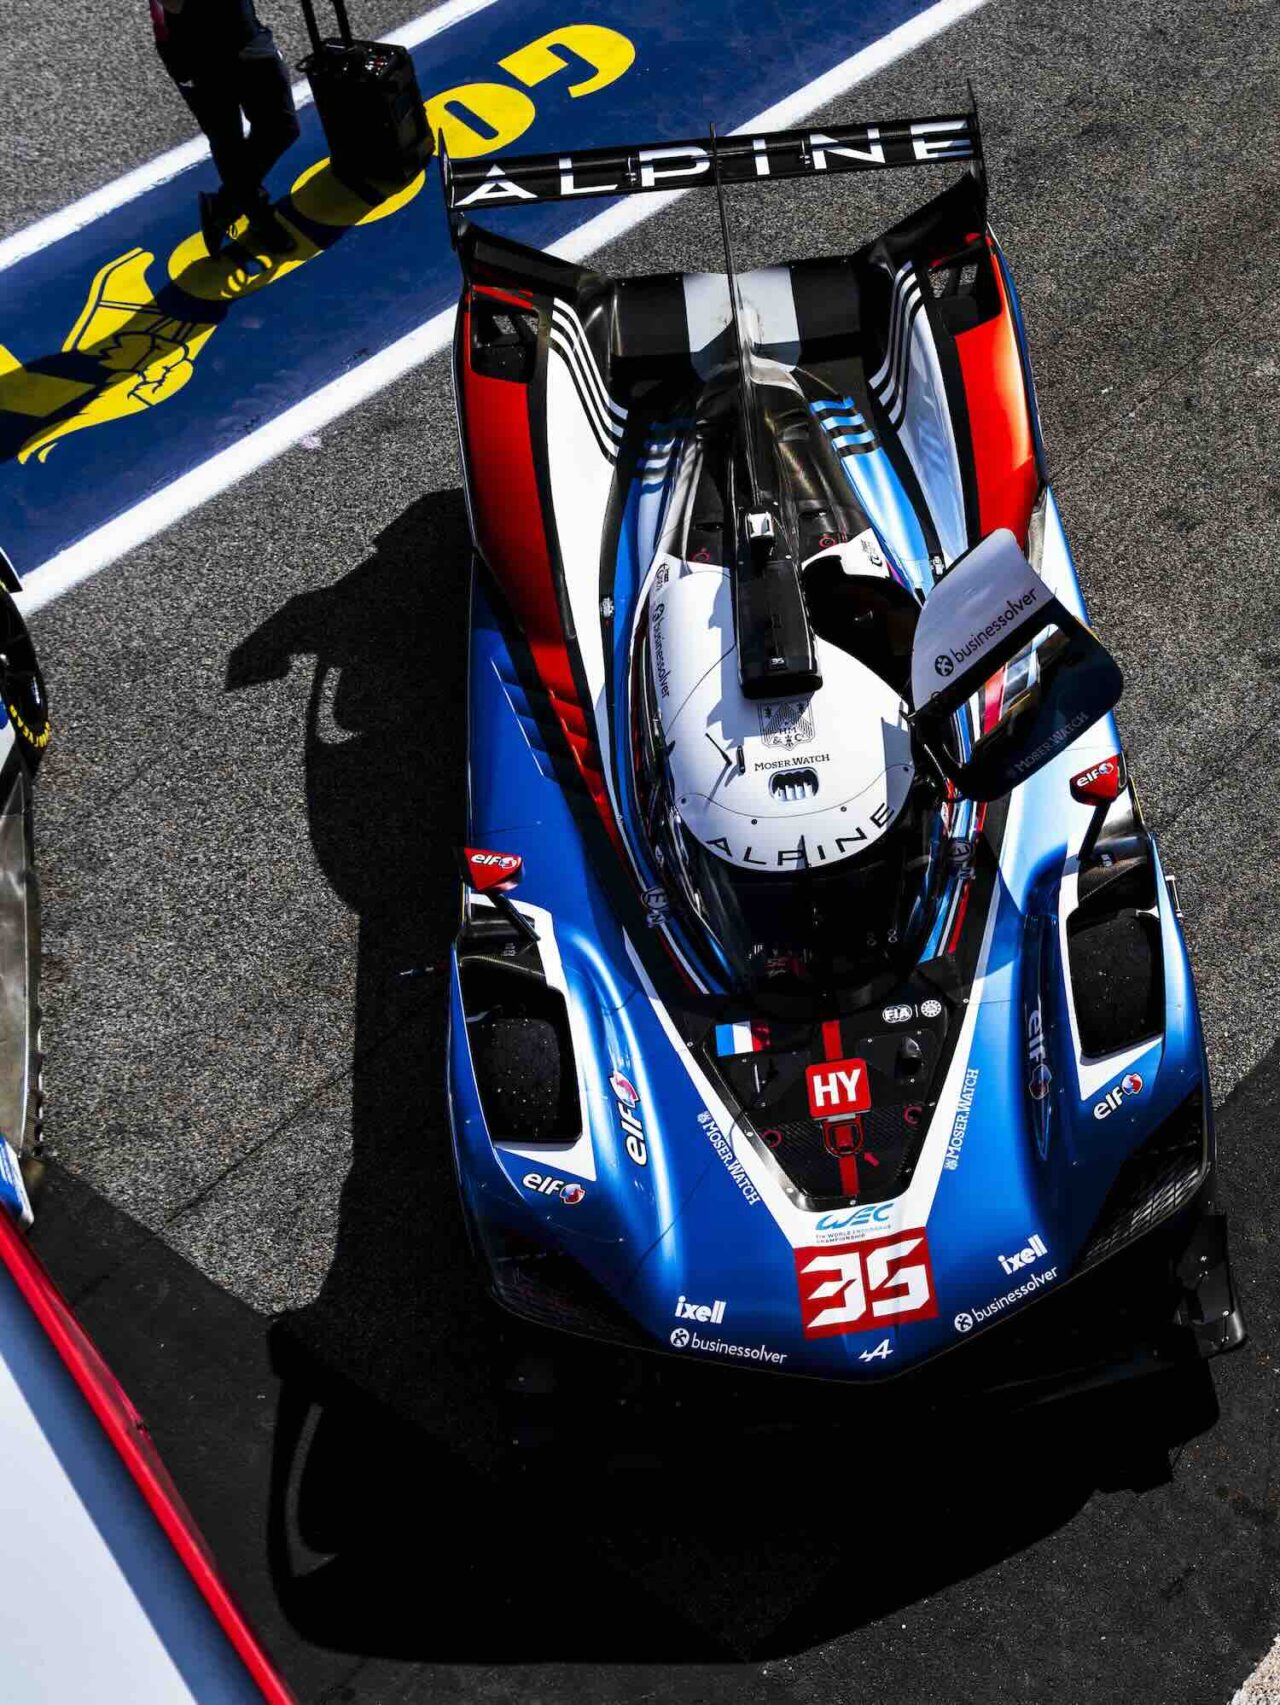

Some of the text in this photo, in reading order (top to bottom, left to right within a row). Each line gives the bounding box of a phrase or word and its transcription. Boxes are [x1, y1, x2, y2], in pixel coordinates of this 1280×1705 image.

[455, 119, 975, 207] ALPINE
[950, 588, 1037, 663] businessolver
[653, 617, 671, 698] businessolver
[1076, 767, 1100, 787] elf
[706, 803, 894, 867] ALPINE
[471, 853, 500, 866] elf
[1028, 1010, 1046, 1062] elf
[812, 1068, 861, 1107] HY
[1093, 1086, 1123, 1120] elf
[618, 1101, 647, 1166] elf
[522, 1173, 564, 1195] elf
[815, 1203, 894, 1231] WEC
[998, 1234, 1048, 1275] ixell
[800, 1237, 930, 1328] 35
[972, 1265, 1058, 1323] businessolver
[674, 1295, 727, 1324] ixell
[691, 1332, 788, 1364] businessolver
